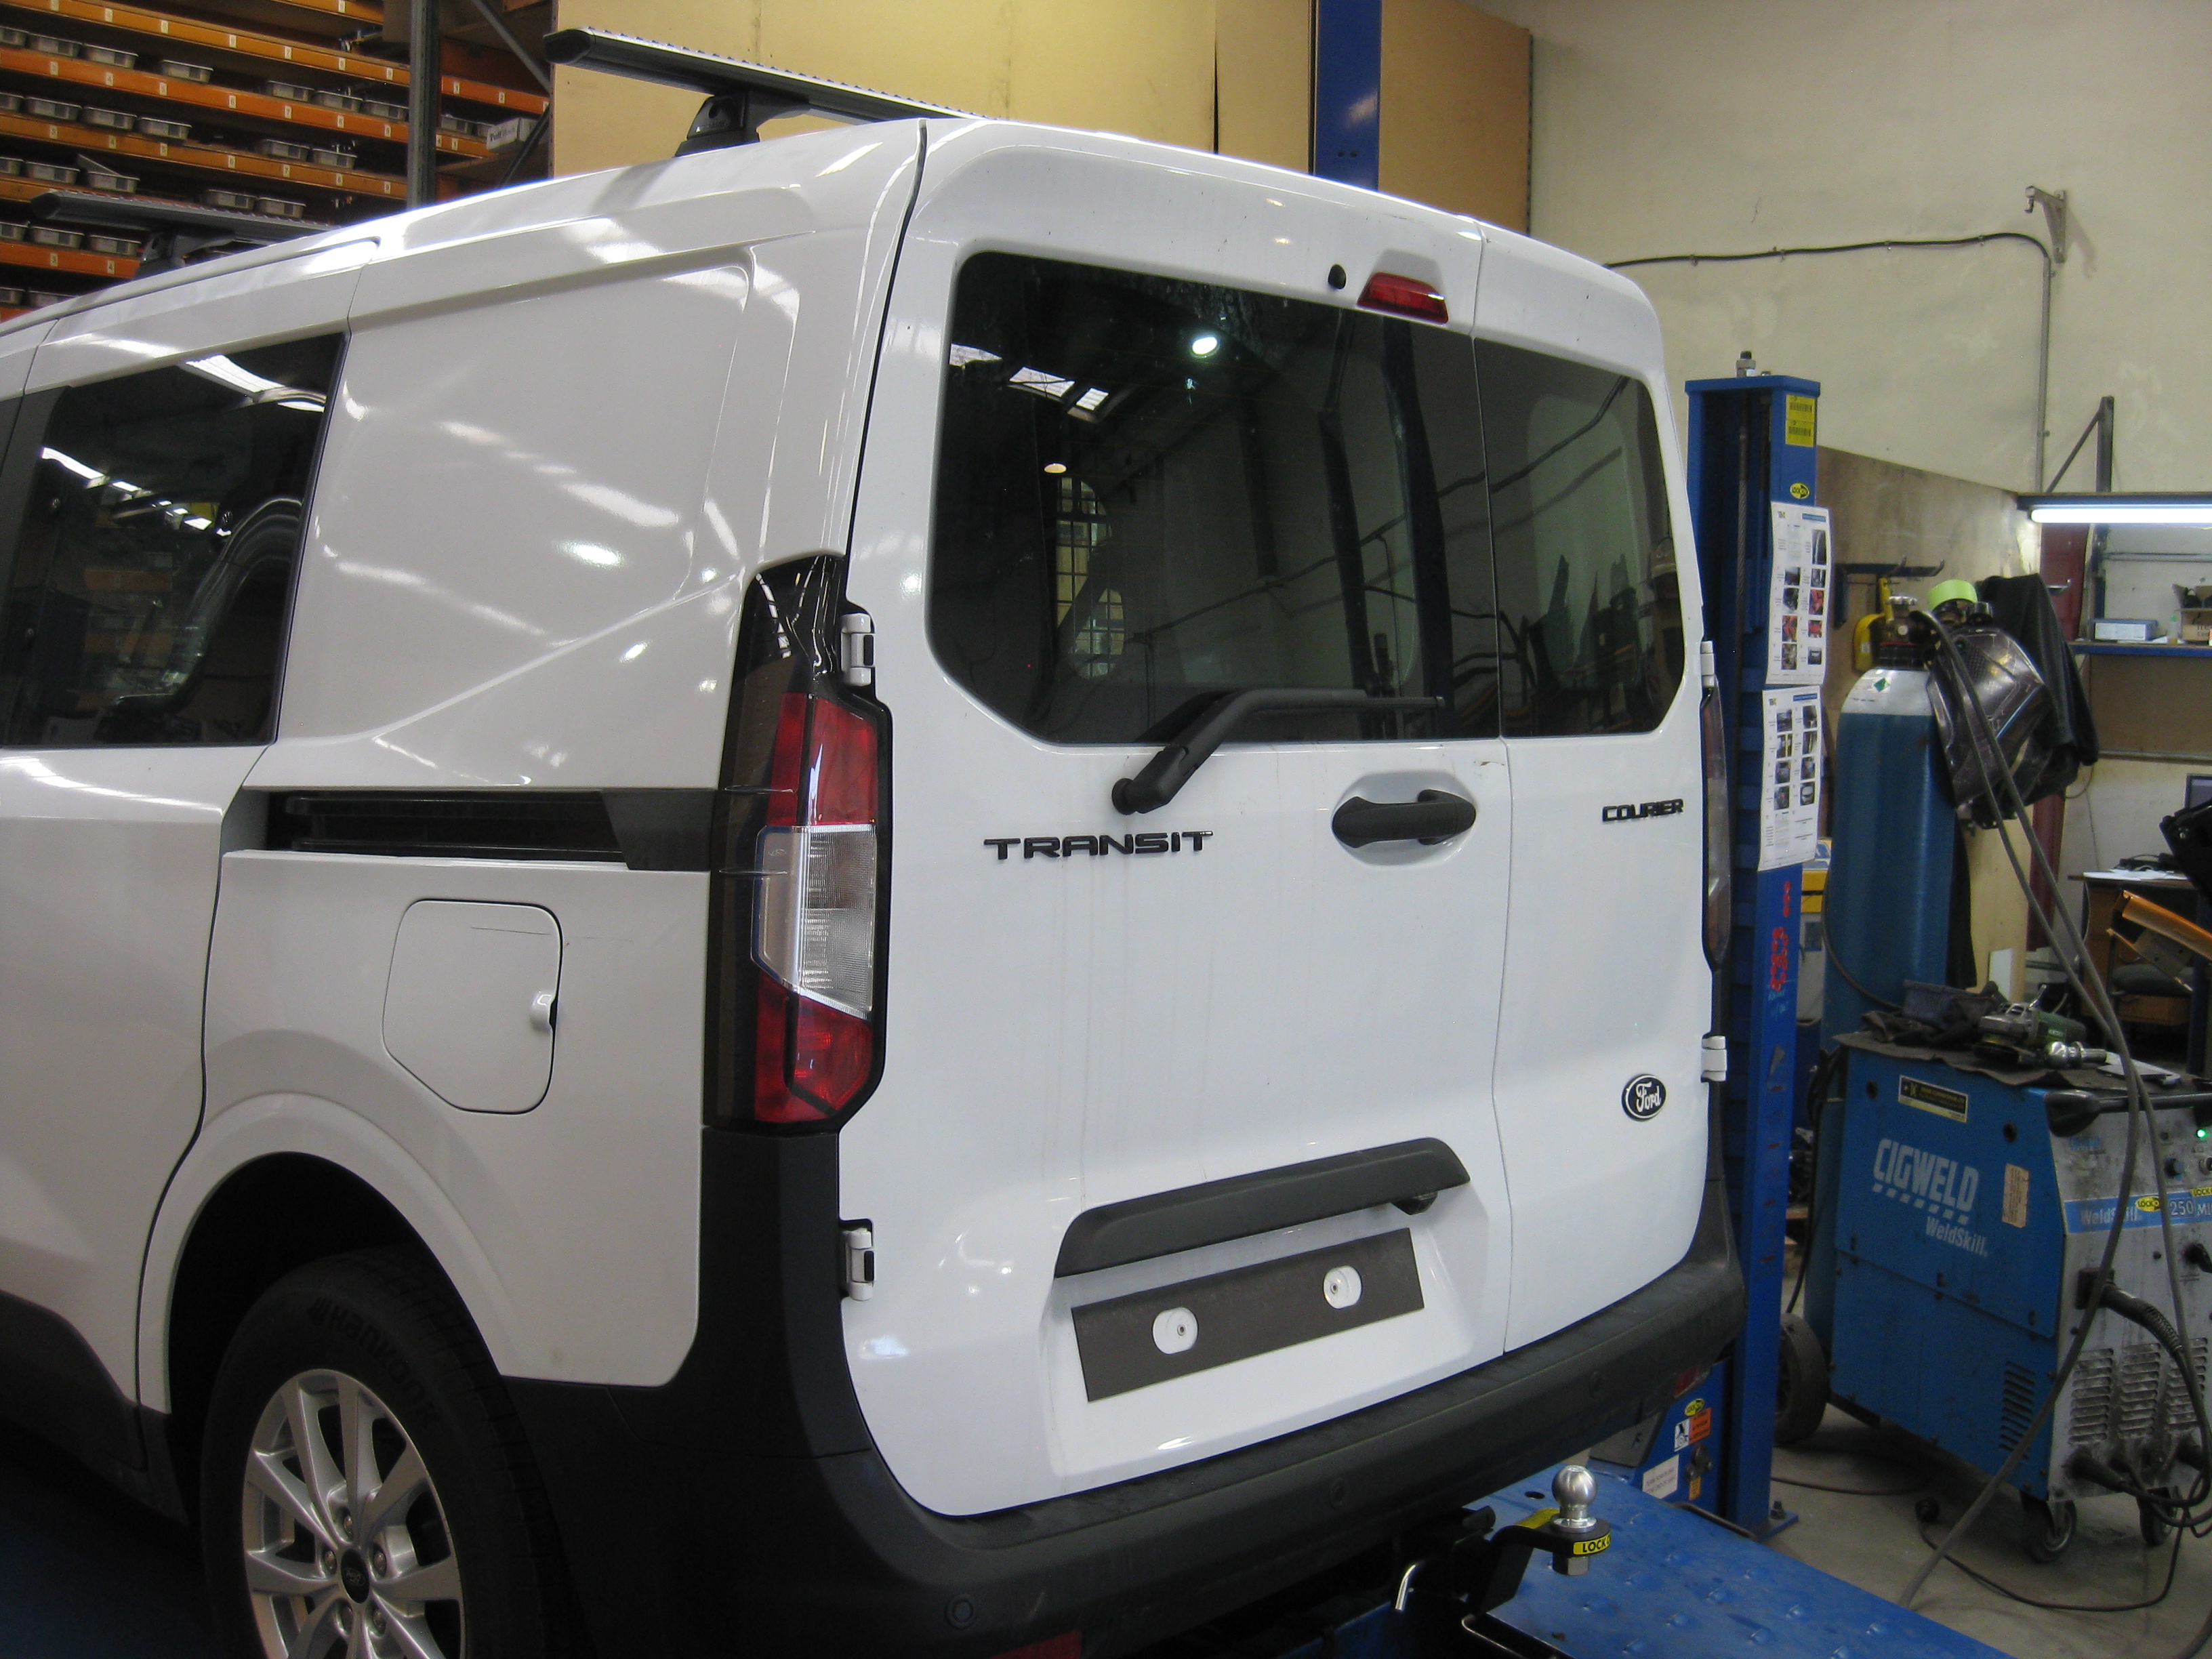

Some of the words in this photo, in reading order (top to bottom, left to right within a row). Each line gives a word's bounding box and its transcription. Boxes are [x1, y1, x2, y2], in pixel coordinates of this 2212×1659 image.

[1602, 798, 1683, 822] COURIER
[983, 830, 1214, 860] TRANSIT
[1635, 1081, 1662, 1113] Ford
[1872, 1138, 1980, 1212] CIGWELD
[2169, 1200, 2194, 1216] 250
[2196, 1202, 2212, 1216] MI
[1582, 1536, 1606, 1553] LOCK
